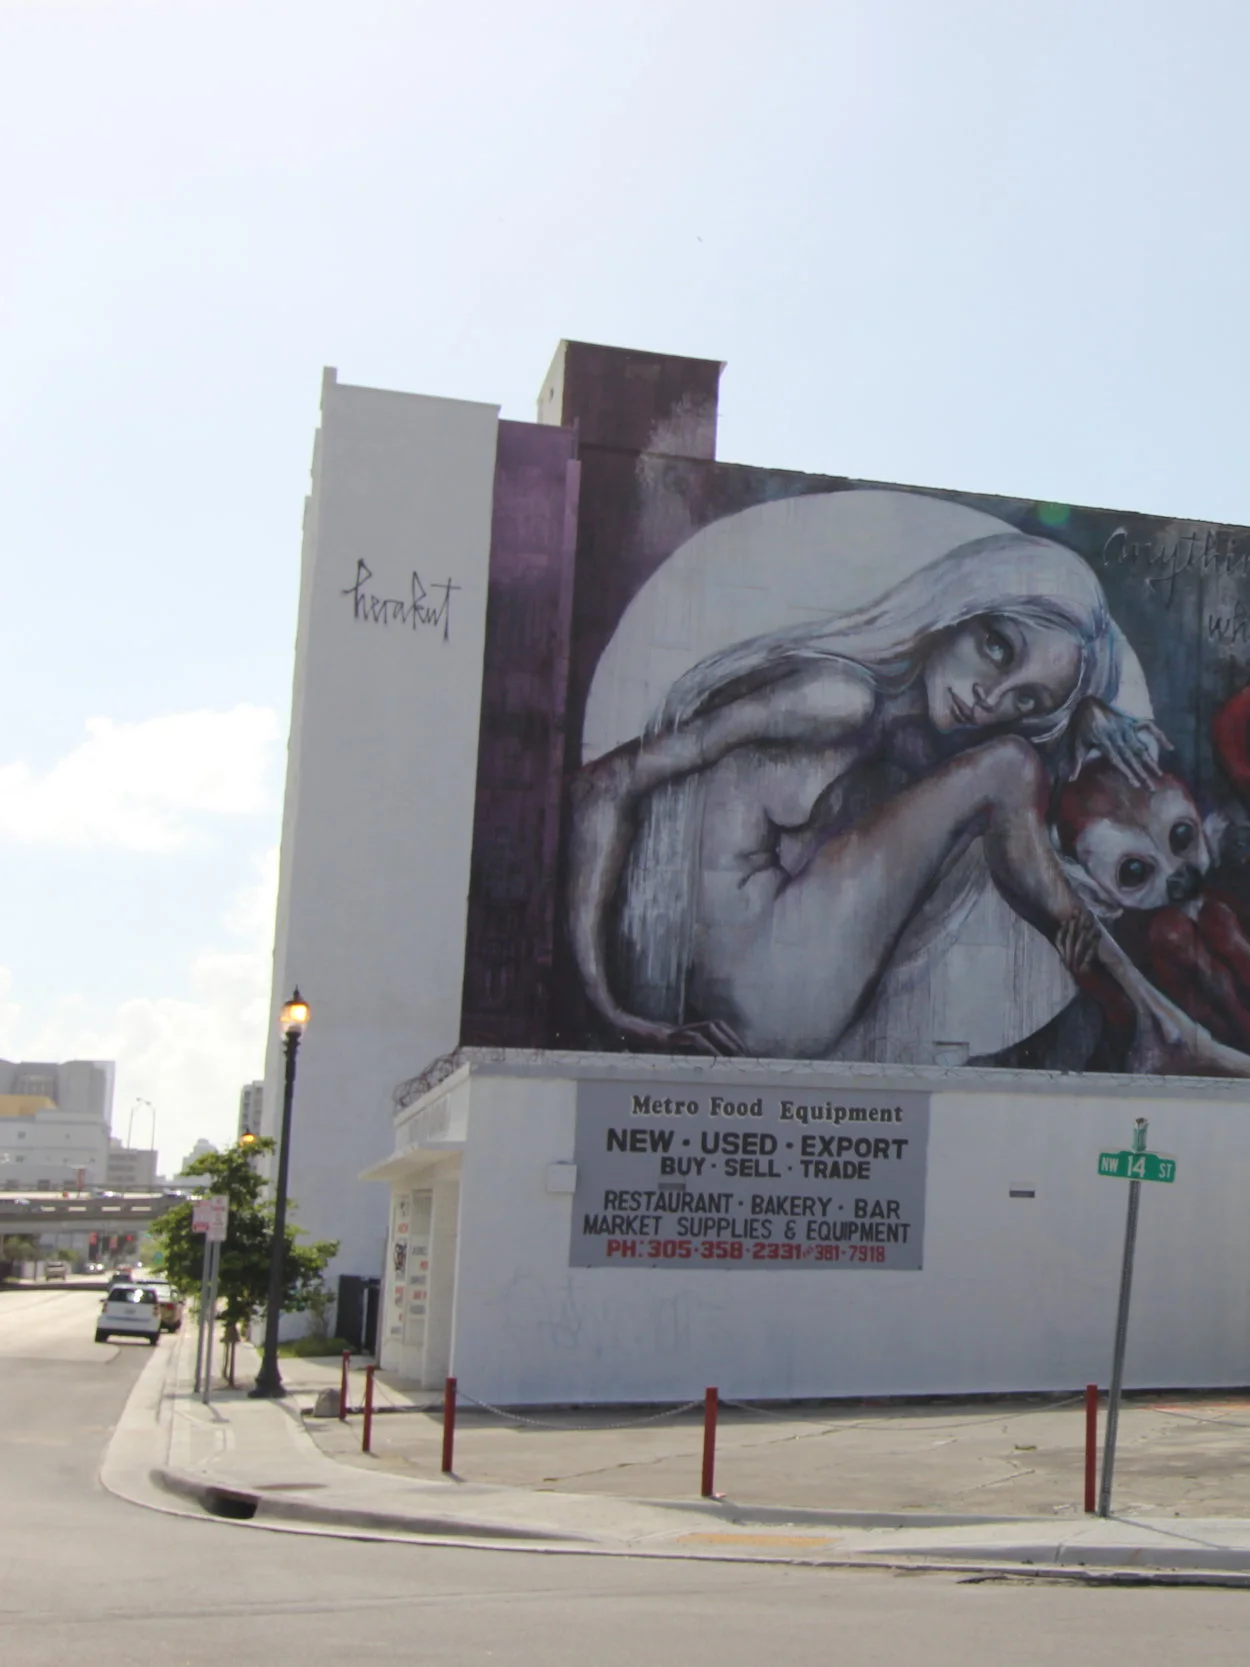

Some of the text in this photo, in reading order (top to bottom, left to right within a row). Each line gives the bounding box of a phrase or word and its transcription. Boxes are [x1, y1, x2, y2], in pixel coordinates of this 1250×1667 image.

[631, 1095, 903, 1125] Metro Food Equipment
[606, 1128, 909, 1160] NEW USED EXPORT
[660, 1156, 871, 1180] BUY SELL TRADE
[1101, 1155, 1173, 1178] NW 14 ST
[603, 1190, 901, 1219] RESTAURANT BAKERY BAR
[583, 1214, 911, 1243] MARKET SUPPLIES & EQUIPMENT
